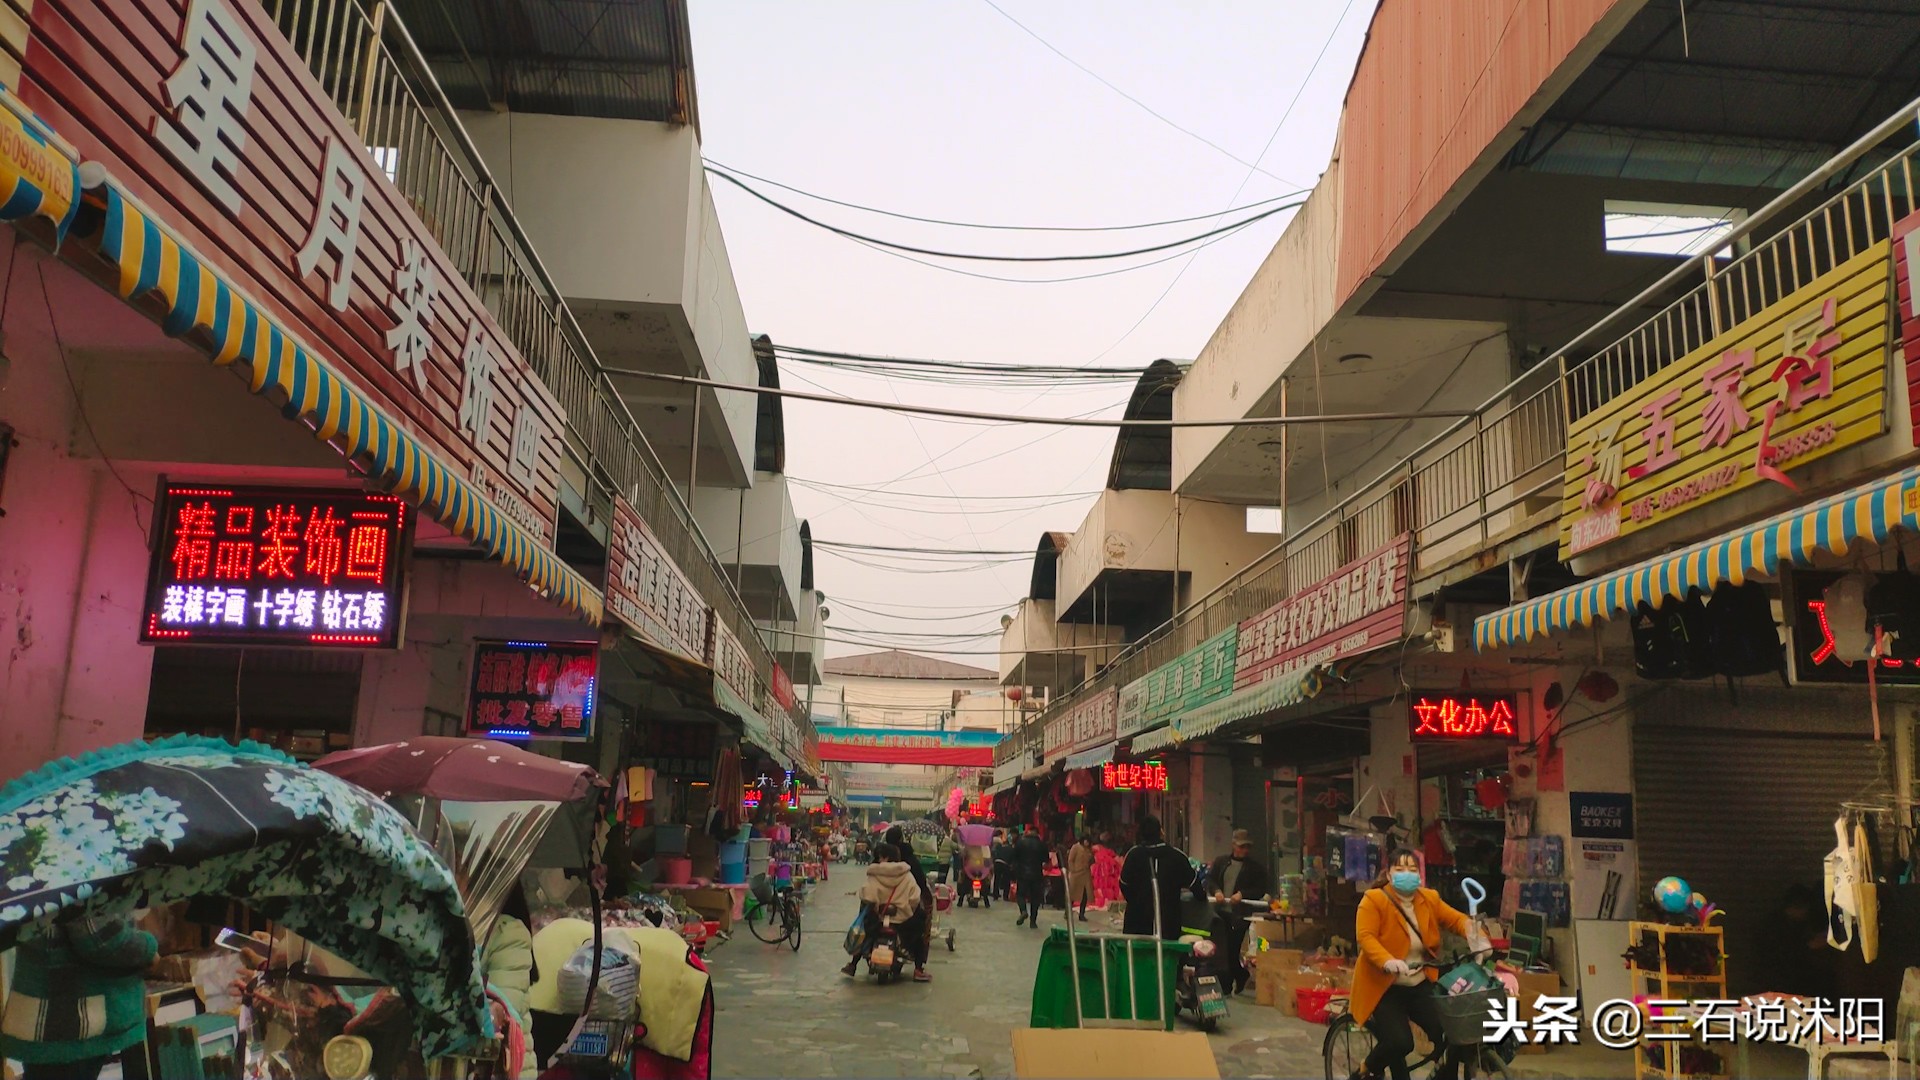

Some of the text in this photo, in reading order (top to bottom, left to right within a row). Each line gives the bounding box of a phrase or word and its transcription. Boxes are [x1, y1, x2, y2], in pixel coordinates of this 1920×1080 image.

[172, 500, 388, 585] 精品装饰画
[161, 584, 387, 630] 装裱字画 十字绣 钻石绣
[476, 699, 583, 728] 批发零售
[1413, 698, 1513, 734] 文化办公
[1103, 762, 1167, 790] 新世纪书店
